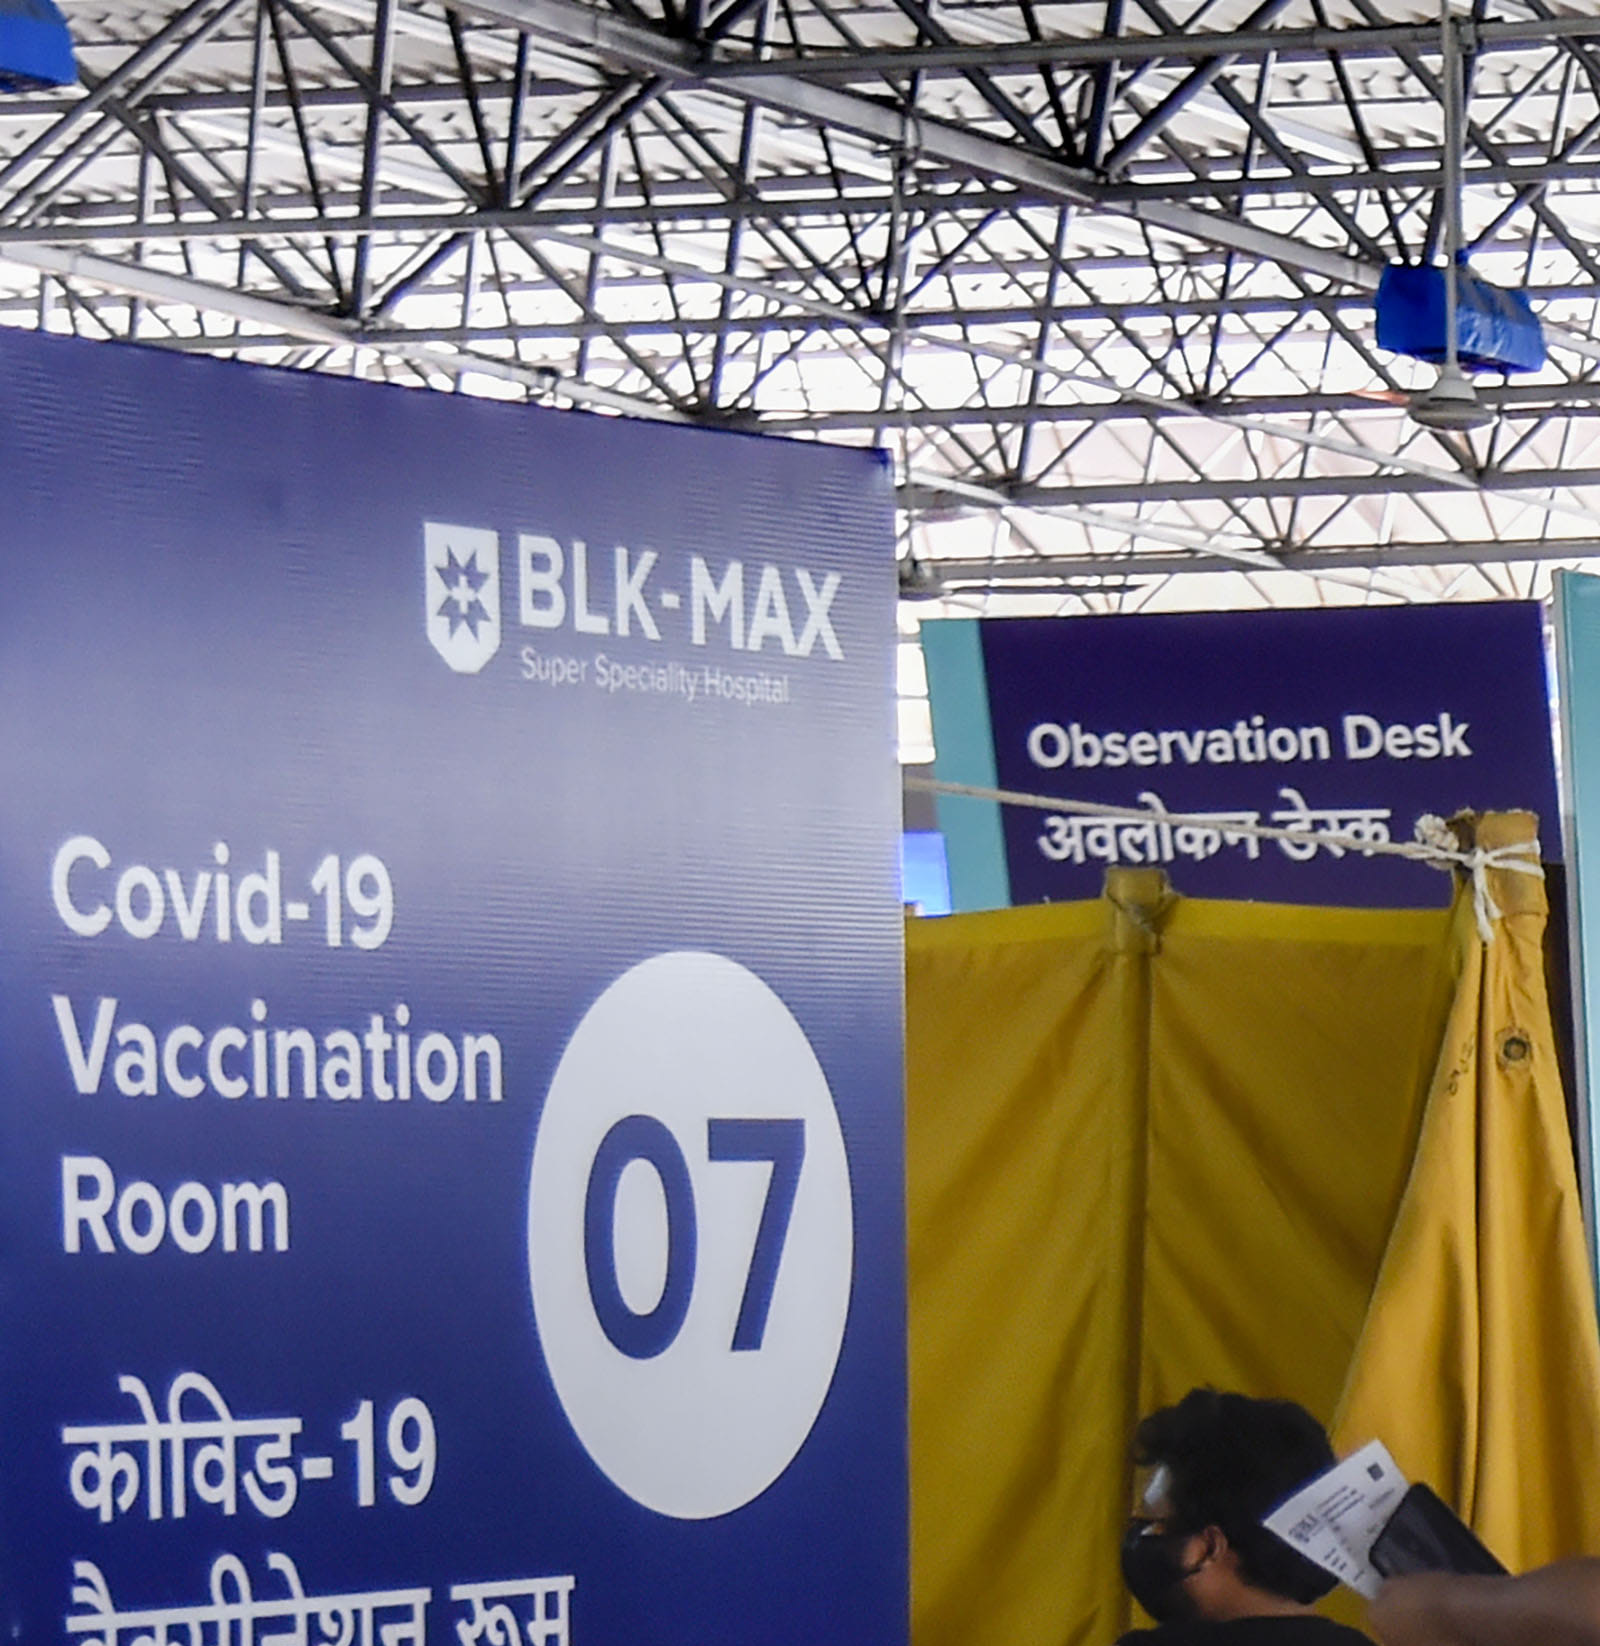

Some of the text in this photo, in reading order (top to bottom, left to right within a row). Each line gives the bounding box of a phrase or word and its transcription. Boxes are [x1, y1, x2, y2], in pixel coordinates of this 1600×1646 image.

[518, 532, 845, 660] BLK-MAX
[520, 645, 790, 707] Super Speciality Hospital
[1027, 712, 1473, 768] Observation Desk
[1038, 788, 1392, 865] अवलोकन डेस्क
[50, 836, 396, 949] Covid-19
[52, 993, 505, 1103] Vaccination
[60, 1155, 290, 1255] Room
[584, 1114, 806, 1360] 07
[61, 1371, 438, 1523] कोविड-19
